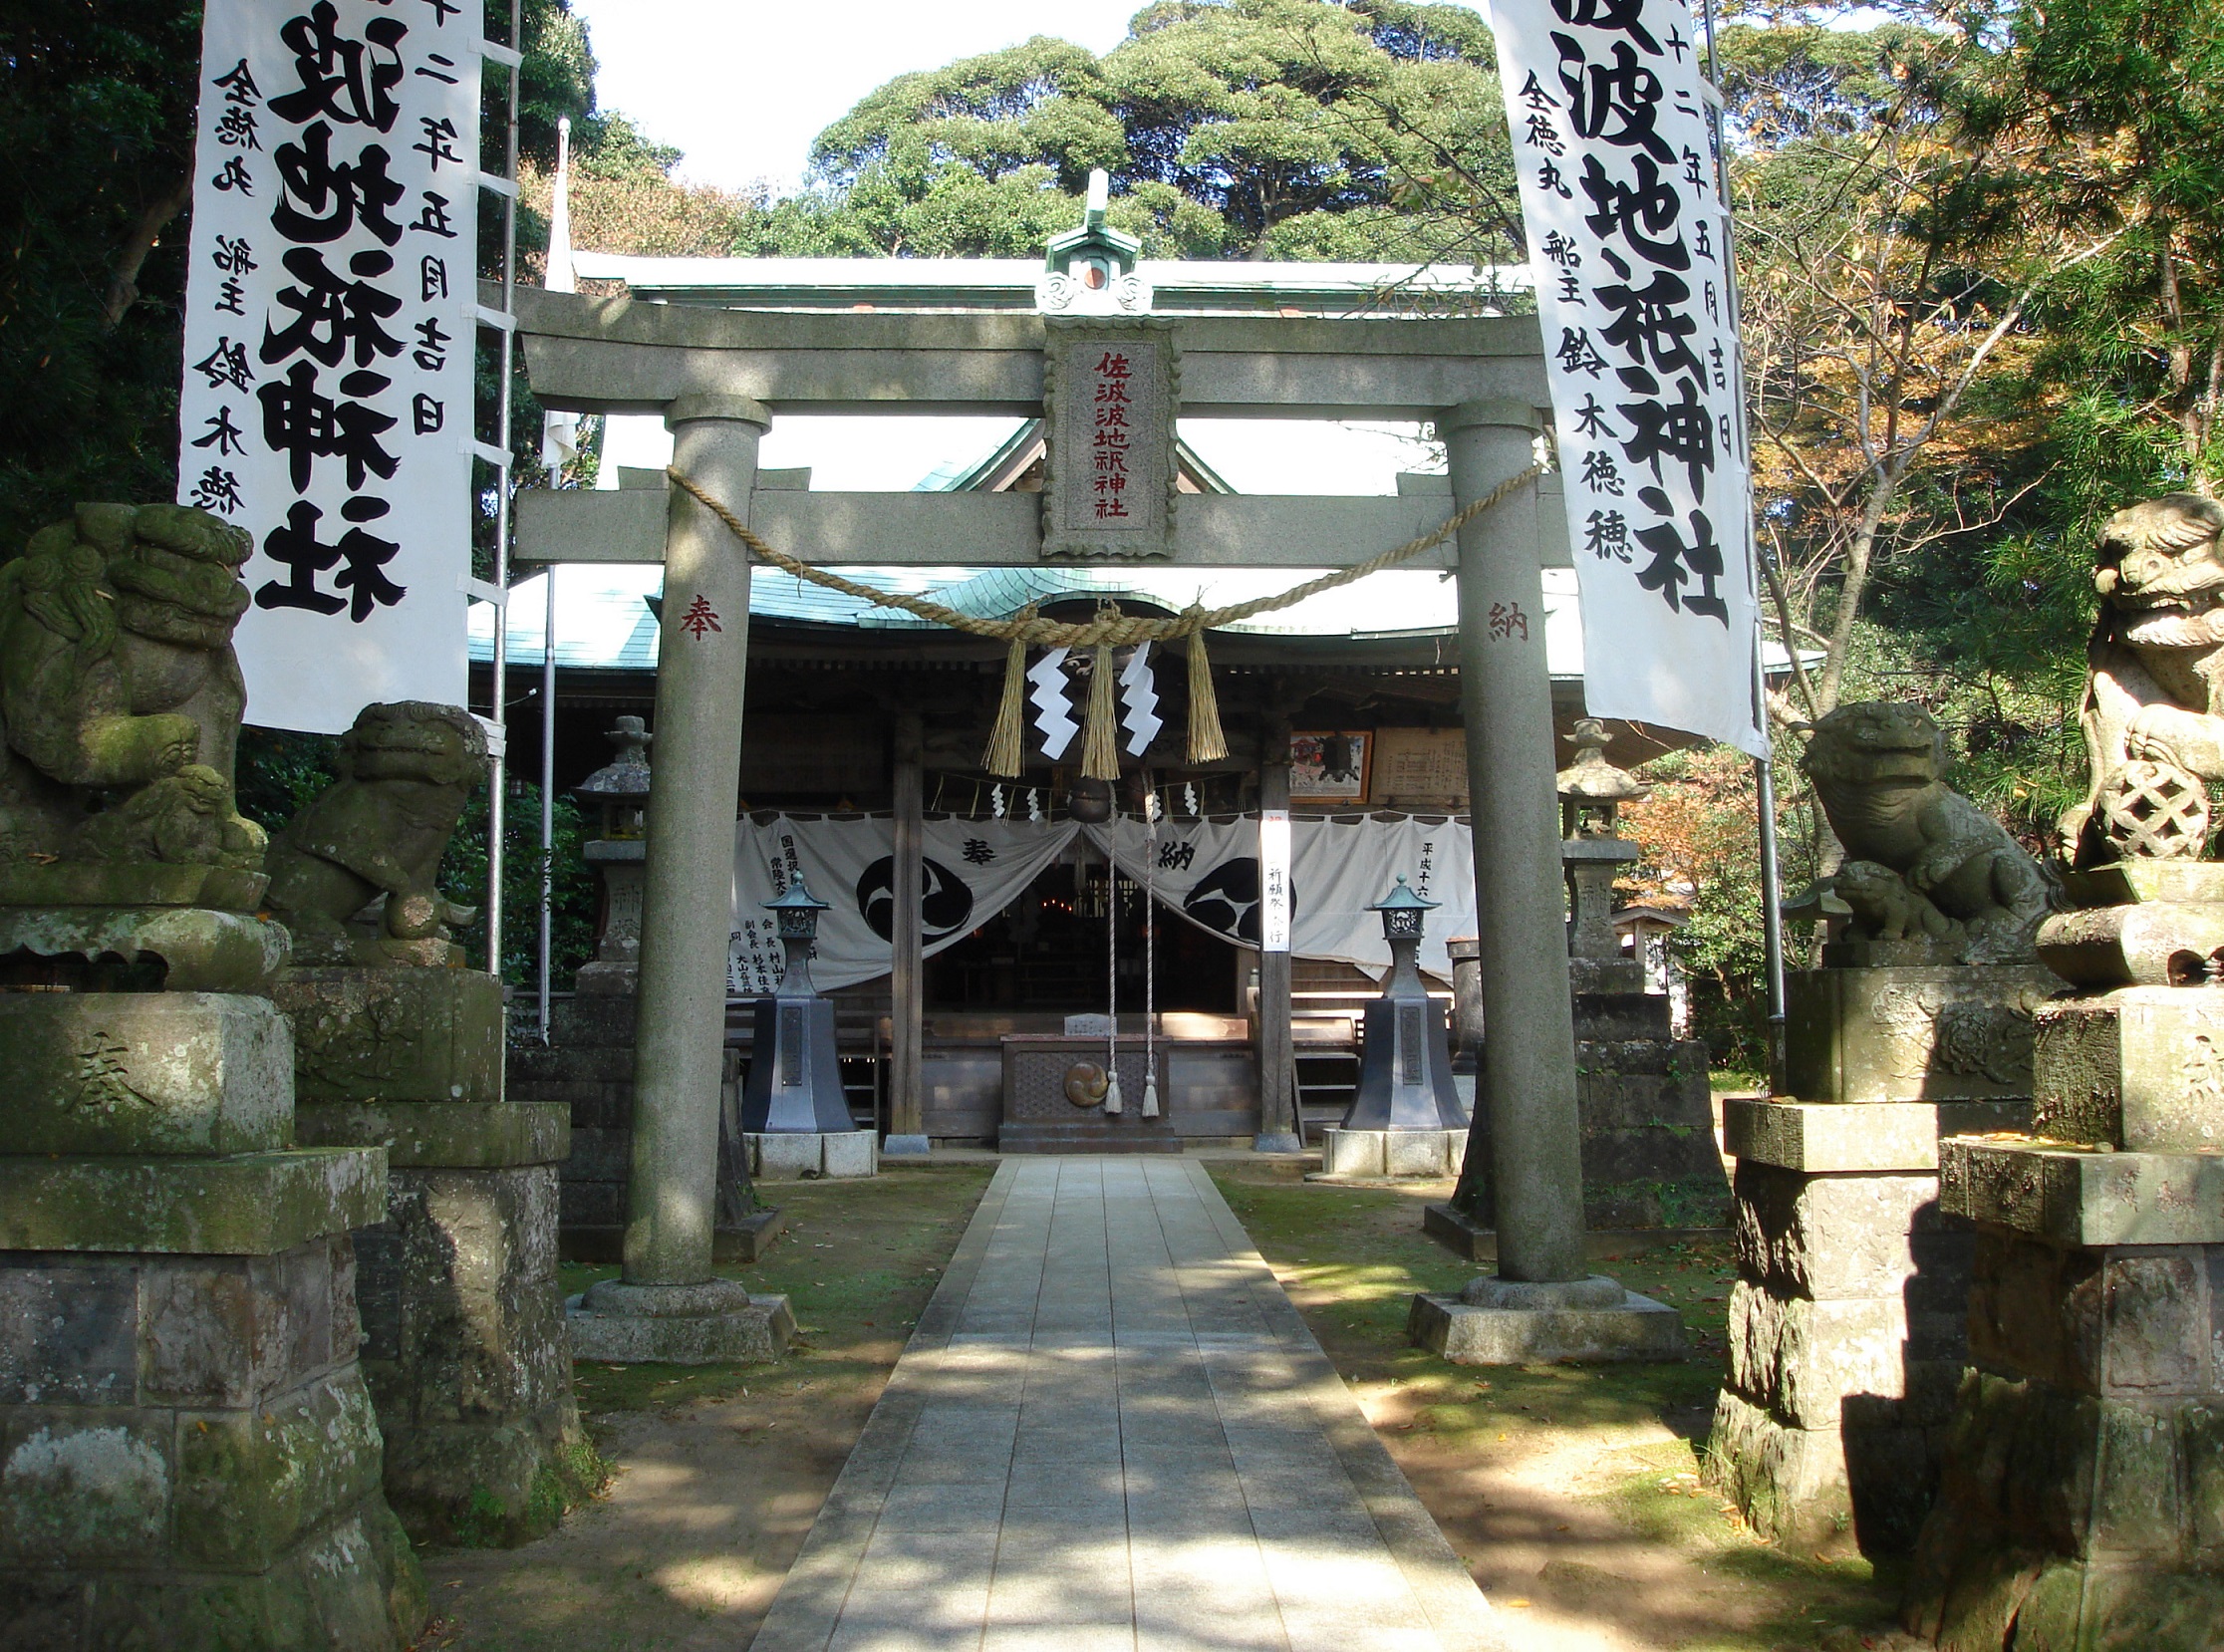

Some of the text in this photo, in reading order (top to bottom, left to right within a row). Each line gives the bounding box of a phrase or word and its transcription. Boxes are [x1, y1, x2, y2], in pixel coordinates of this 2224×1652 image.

[1094, 352, 1132, 519] 佐波波地祇神社
[680, 595, 721, 641] 奉
[1489, 602, 1529, 642] 納
[963, 838, 996, 865] 奉
[1158, 842, 1195, 871] 納
[64, 1030, 156, 1114] 奉
